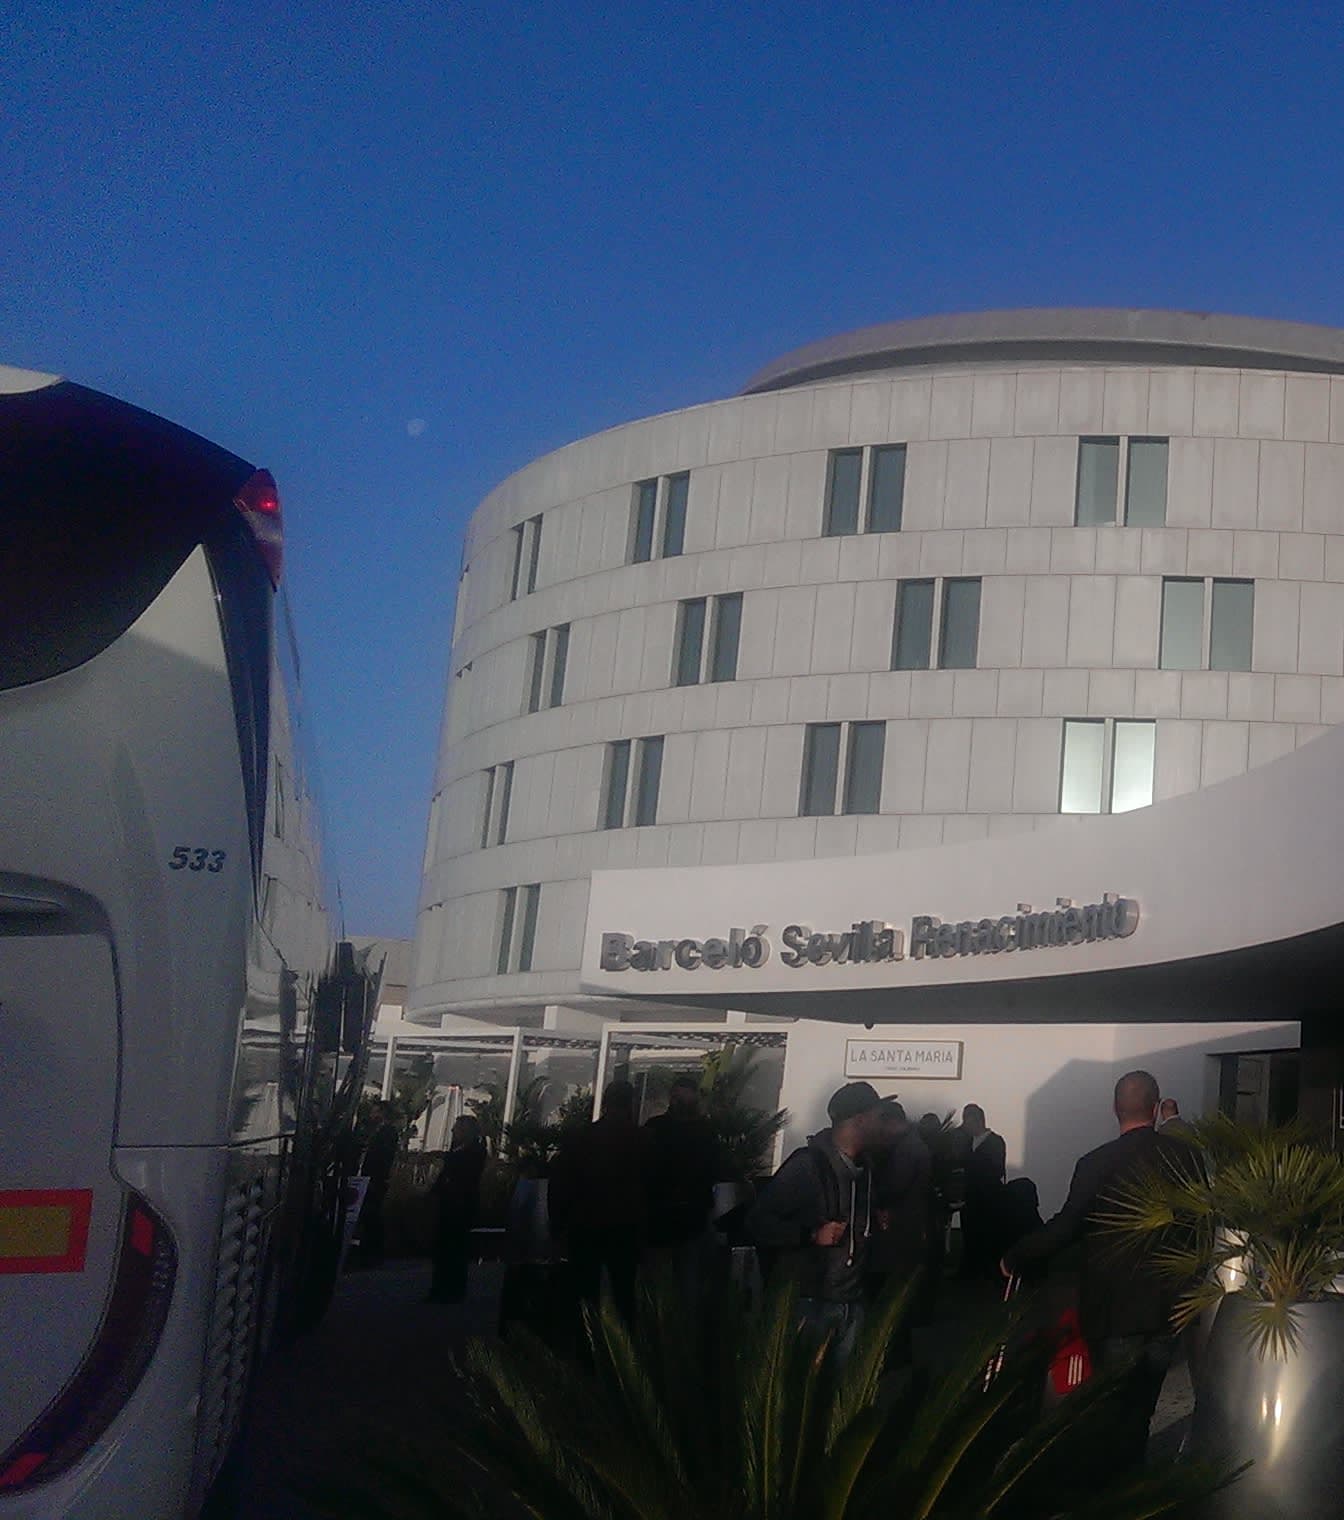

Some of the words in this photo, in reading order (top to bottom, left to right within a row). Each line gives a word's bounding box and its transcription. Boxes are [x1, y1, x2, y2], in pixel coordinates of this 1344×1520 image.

[168, 847, 227, 873] 533
[600, 924, 771, 971] Barceló
[780, 920, 905, 968] Sevilla
[910, 892, 1140, 960] Renacimiento
[851, 1050, 867, 1062] LA
[871, 1050, 912, 1063] SANTA
[915, 1051, 953, 1063] MARIA
